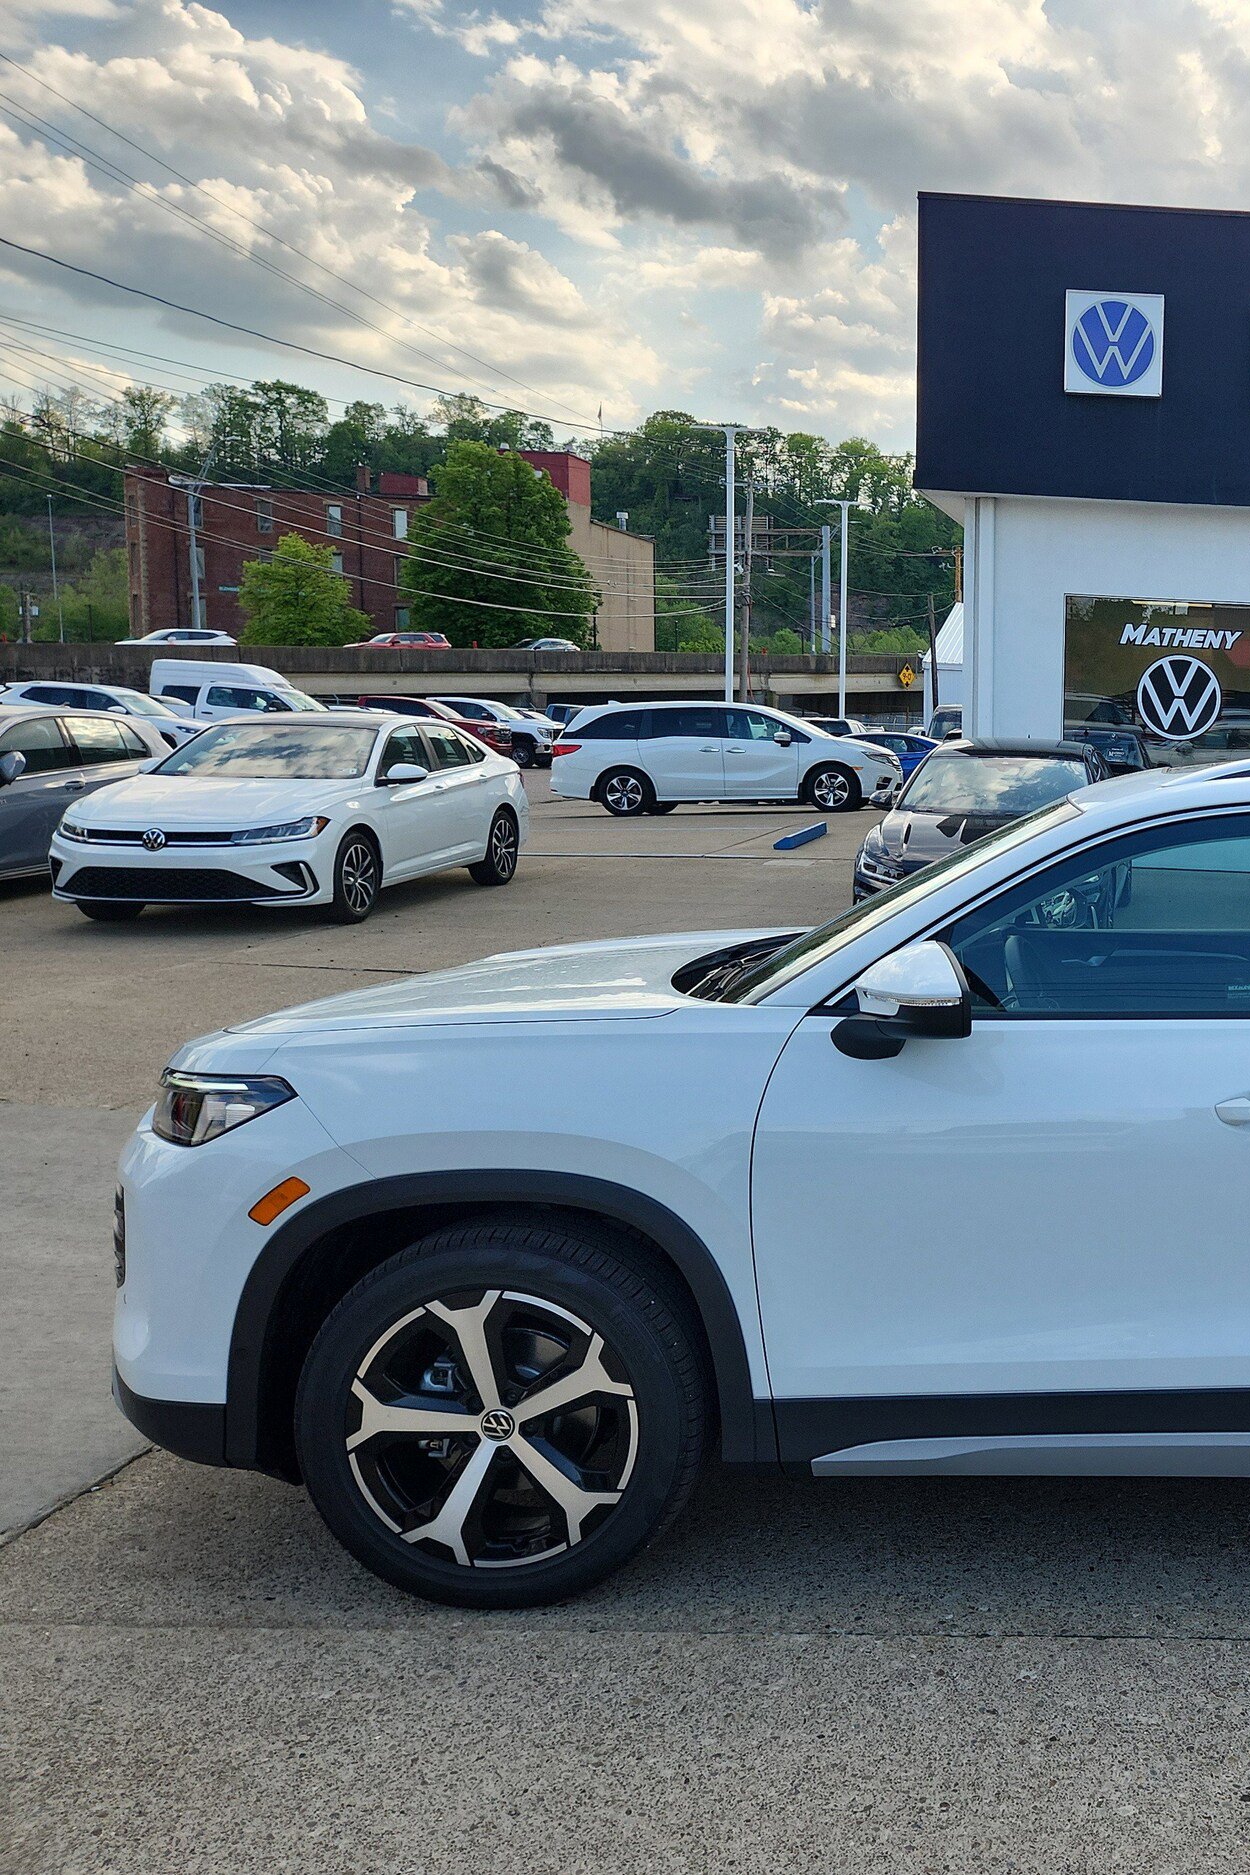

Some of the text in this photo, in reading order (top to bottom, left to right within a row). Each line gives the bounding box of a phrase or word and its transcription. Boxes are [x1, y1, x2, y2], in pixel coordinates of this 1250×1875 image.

[1073, 301, 1155, 387] VW
[1119, 623, 1243, 649] MATHENY
[1137, 654, 1222, 740] VW
